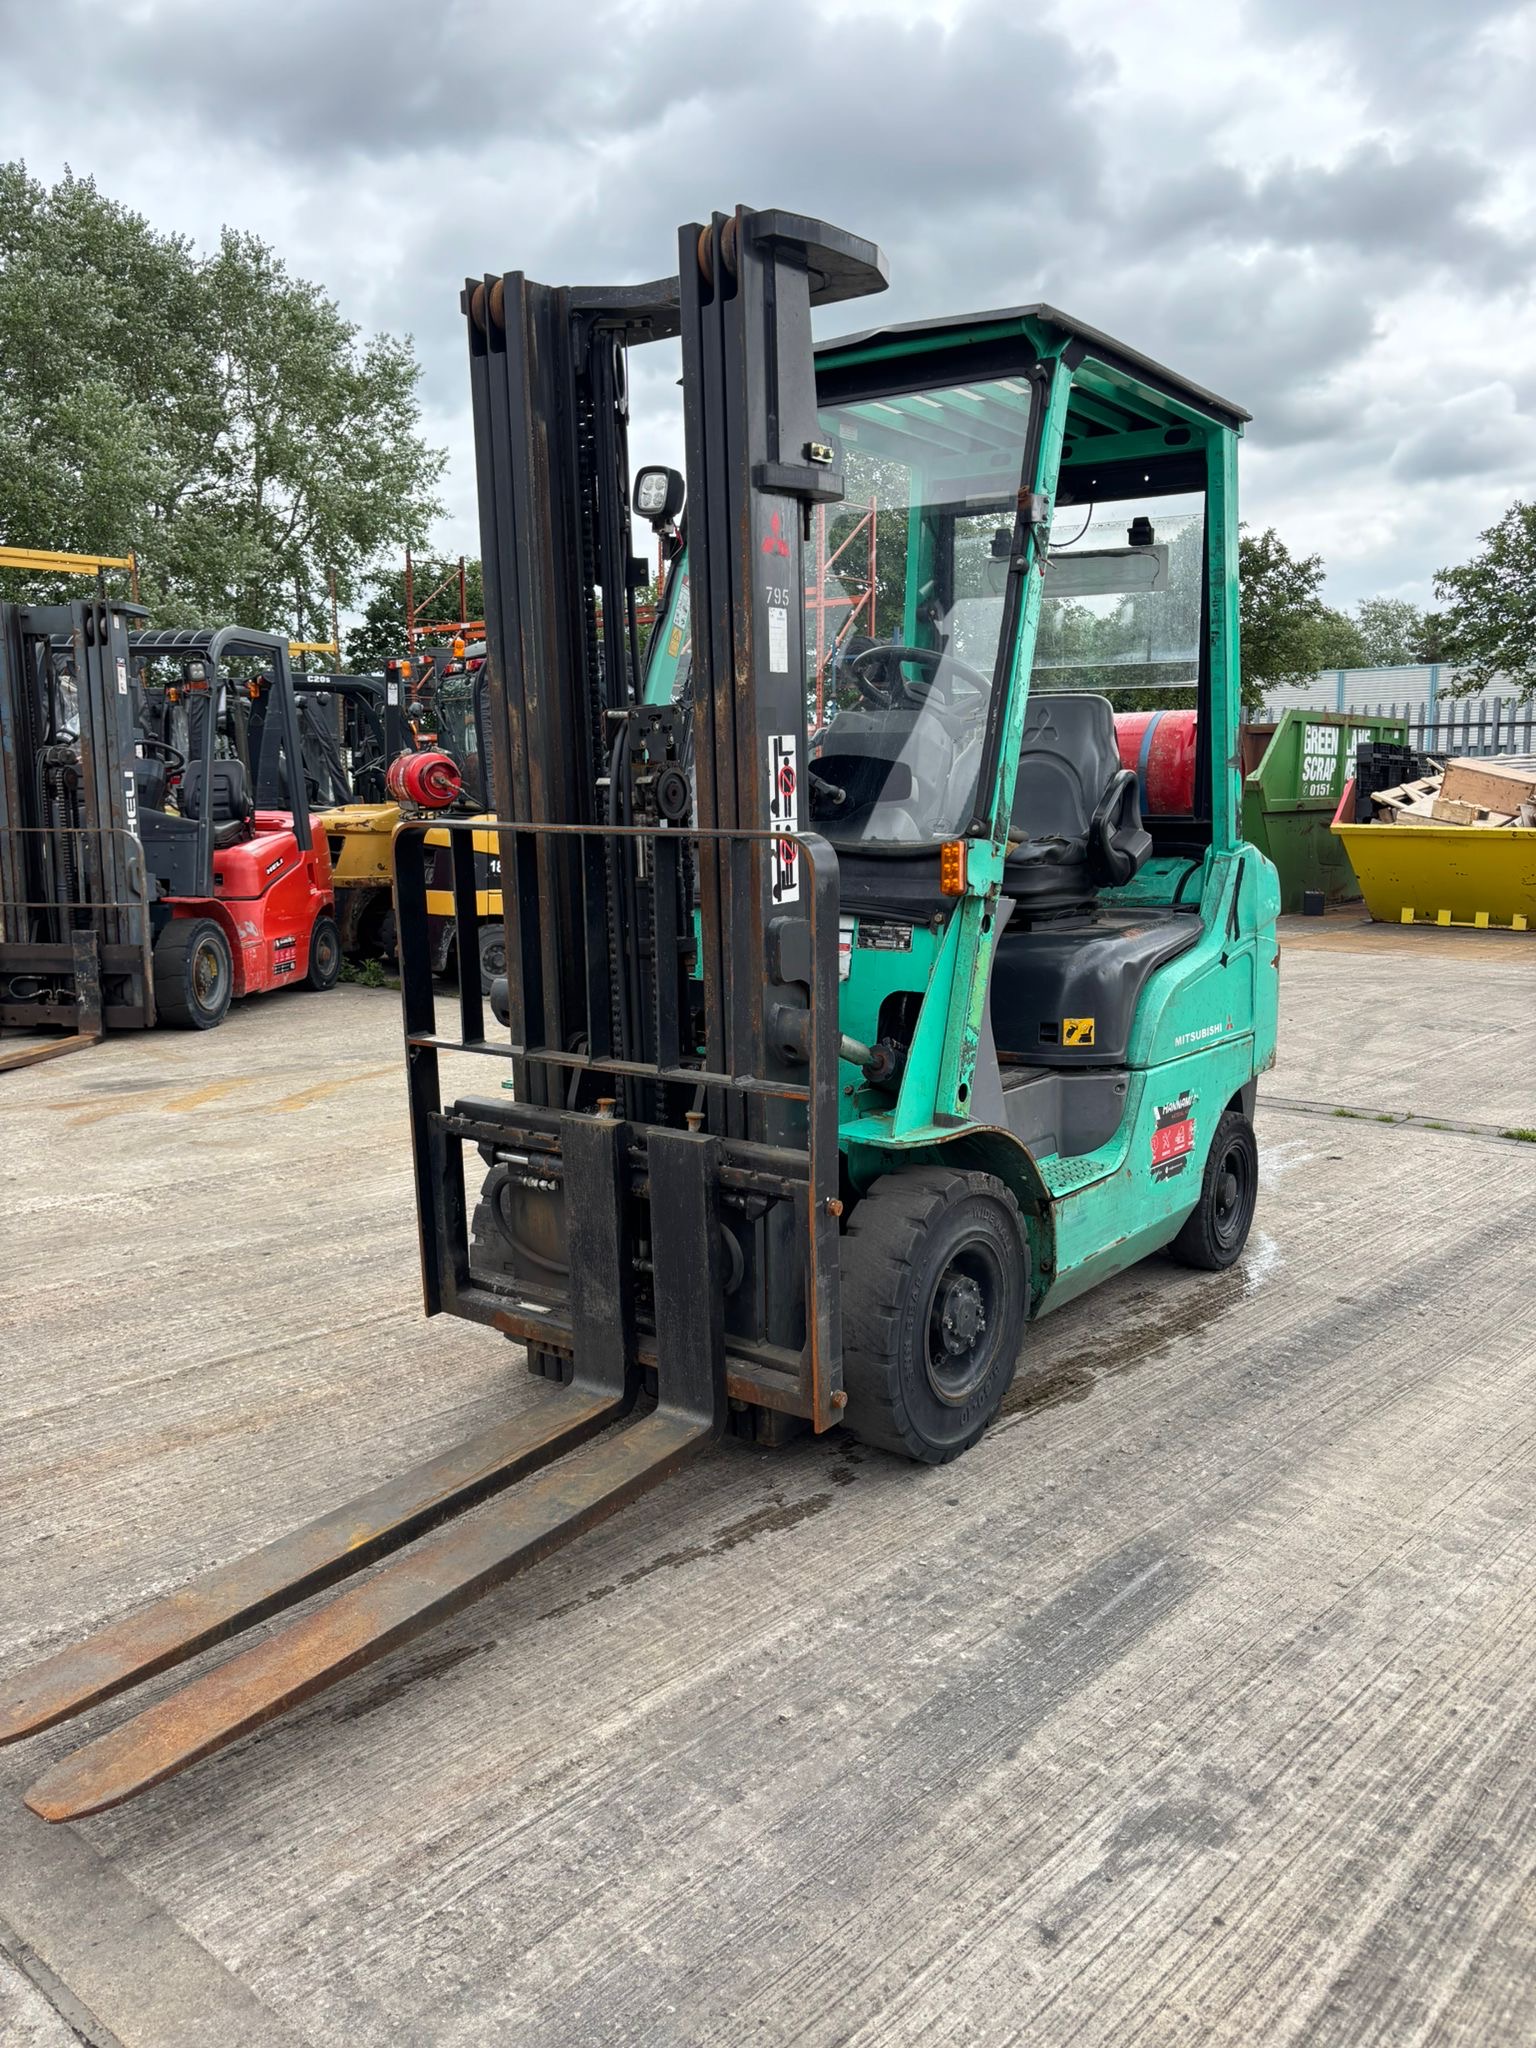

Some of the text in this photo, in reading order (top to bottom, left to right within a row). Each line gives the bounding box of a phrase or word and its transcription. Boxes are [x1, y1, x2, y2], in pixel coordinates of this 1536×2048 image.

[766, 586, 789, 606] 795
[1303, 725, 1339, 755] GREEN
[1302, 756, 1337, 781] SCRAP
[124, 771, 138, 838] HELI
[266, 858, 284, 875] HELI
[1174, 1023, 1222, 1047] MITSUBISHI
